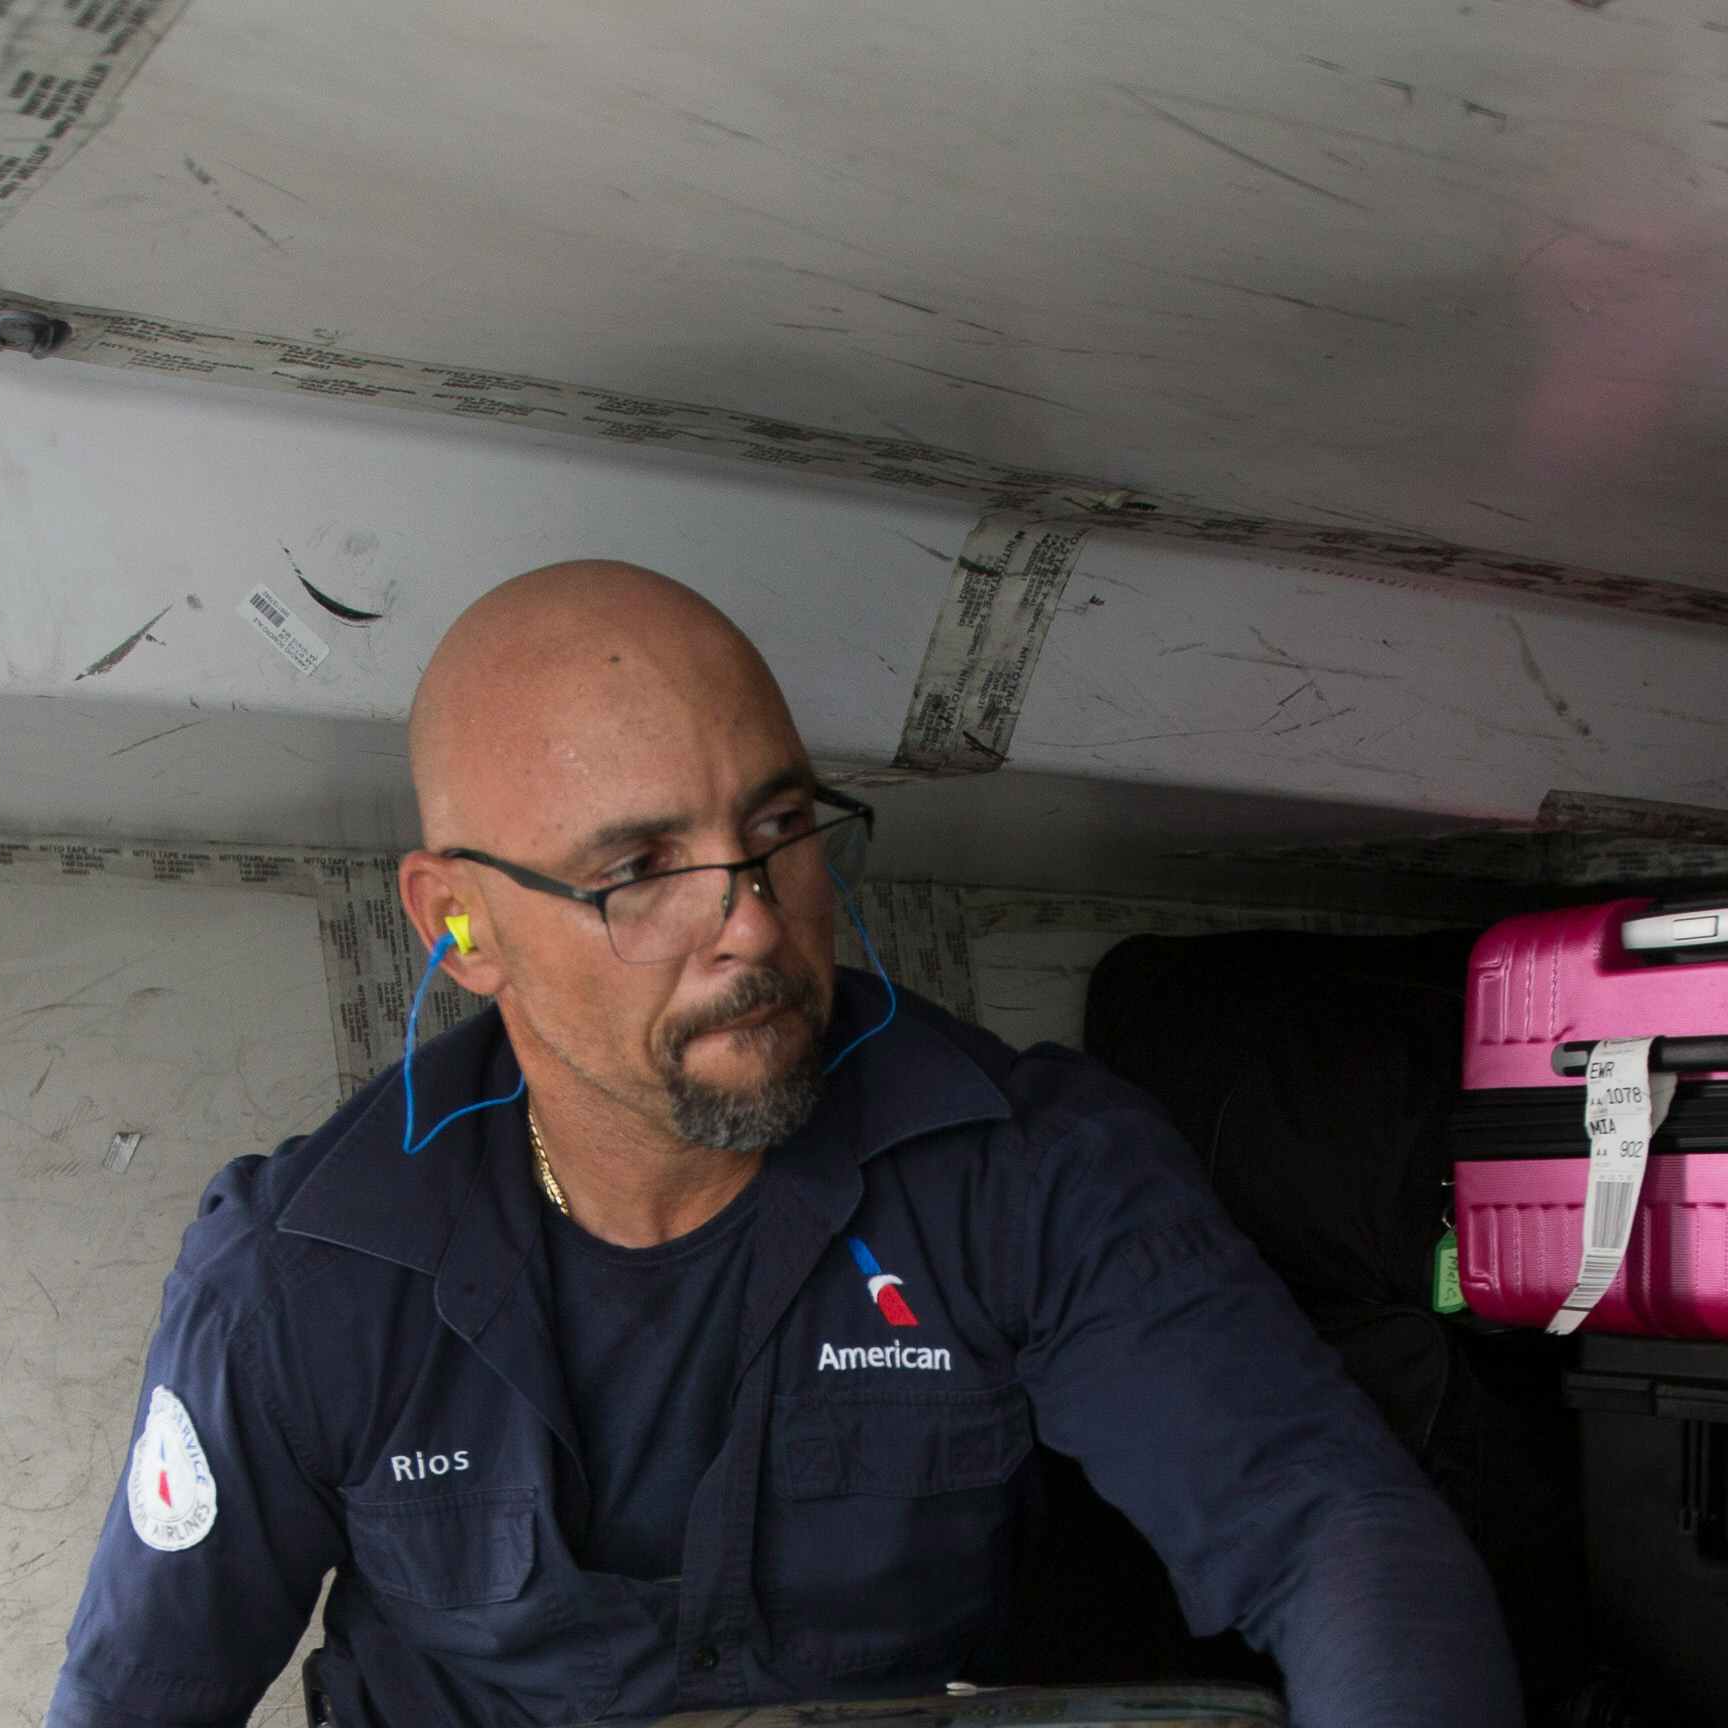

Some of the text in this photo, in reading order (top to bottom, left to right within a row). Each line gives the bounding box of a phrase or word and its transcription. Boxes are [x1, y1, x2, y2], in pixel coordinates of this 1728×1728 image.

[1589, 1061, 1615, 1080] EWR
[1606, 1086, 1642, 1104] 1078
[1589, 1118, 1617, 1136] MIA
[1620, 1140, 1644, 1158] 902
[817, 1339, 952, 1371] American
[390, 1450, 470, 1481] Rios
